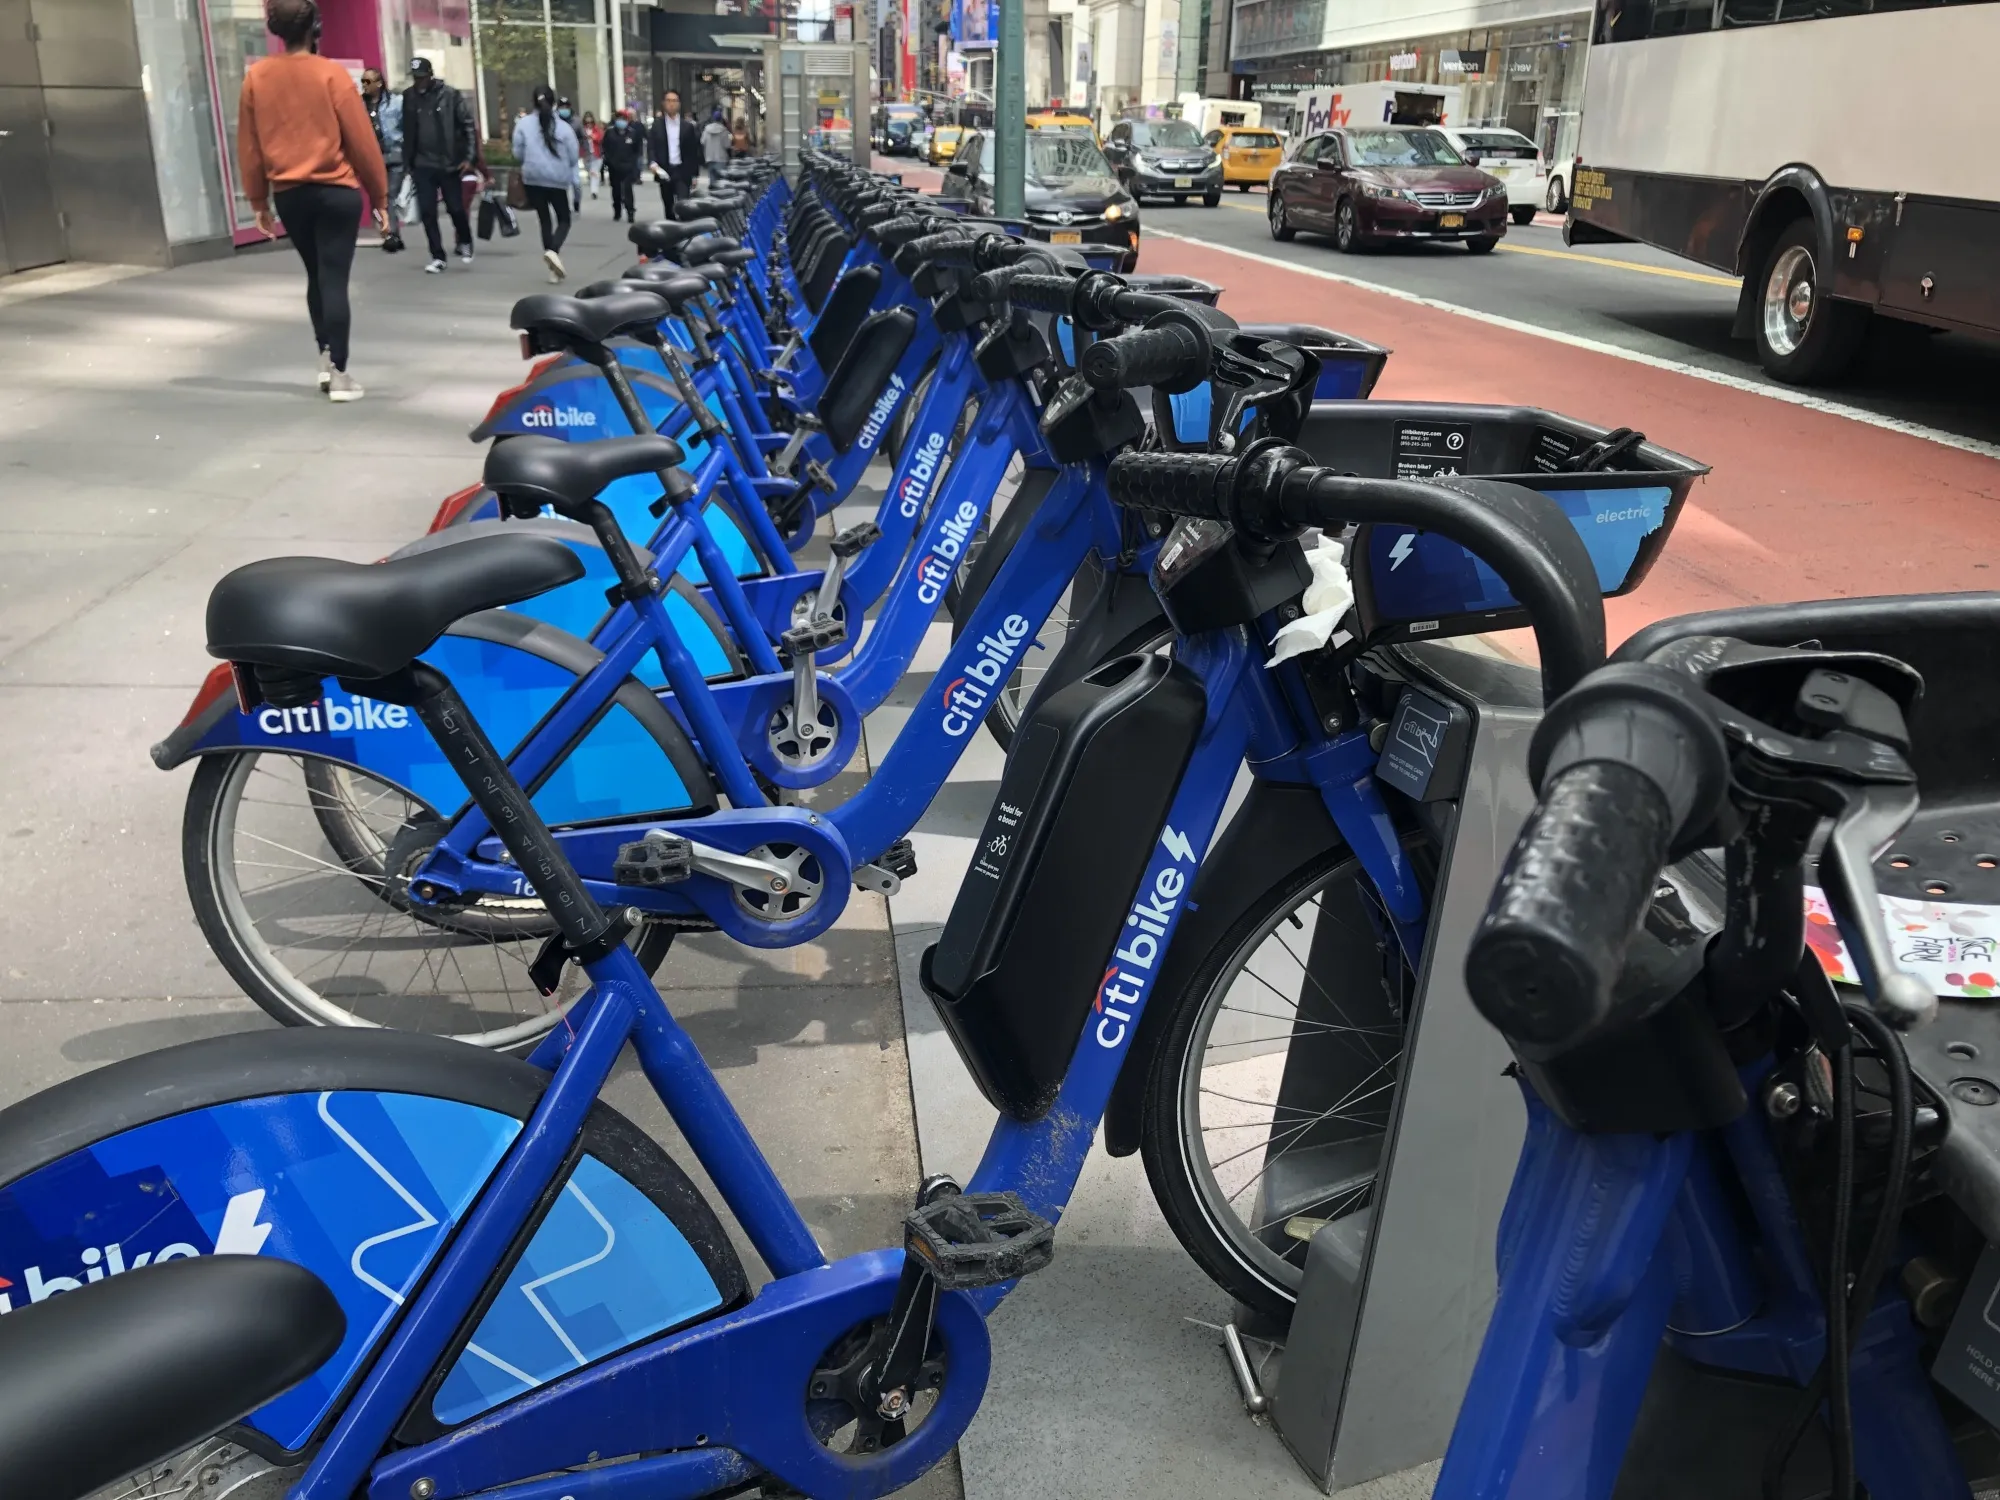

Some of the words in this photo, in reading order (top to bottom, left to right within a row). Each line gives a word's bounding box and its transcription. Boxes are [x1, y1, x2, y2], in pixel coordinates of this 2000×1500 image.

[1389, 48, 1418, 71] verizon
[1443, 59, 1479, 72] verizon
[521, 405, 553, 427] citi
[554, 405, 597, 427] bike
[869, 388, 901, 425] bike
[858, 421, 881, 450] citi
[909, 431, 945, 488] bike
[899, 477, 924, 519] citi
[1596, 505, 1651, 524] electric
[931, 500, 979, 562] bike
[917, 554, 950, 605] citi
[963, 613, 1030, 689] bike
[259, 702, 321, 735] citi
[324, 695, 409, 732] bike
[942, 677, 987, 738] citi
[1000, 801, 1016, 816] Pedal
[1002, 814, 1018, 827] boost
[1115, 867, 1185, 970] bike
[1900, 935, 1954, 963] FARM
[1095, 966, 1145, 1049] citi
[1966, 1344, 1993, 1368] HOLD
[1968, 1362, 1995, 1388] HERE
